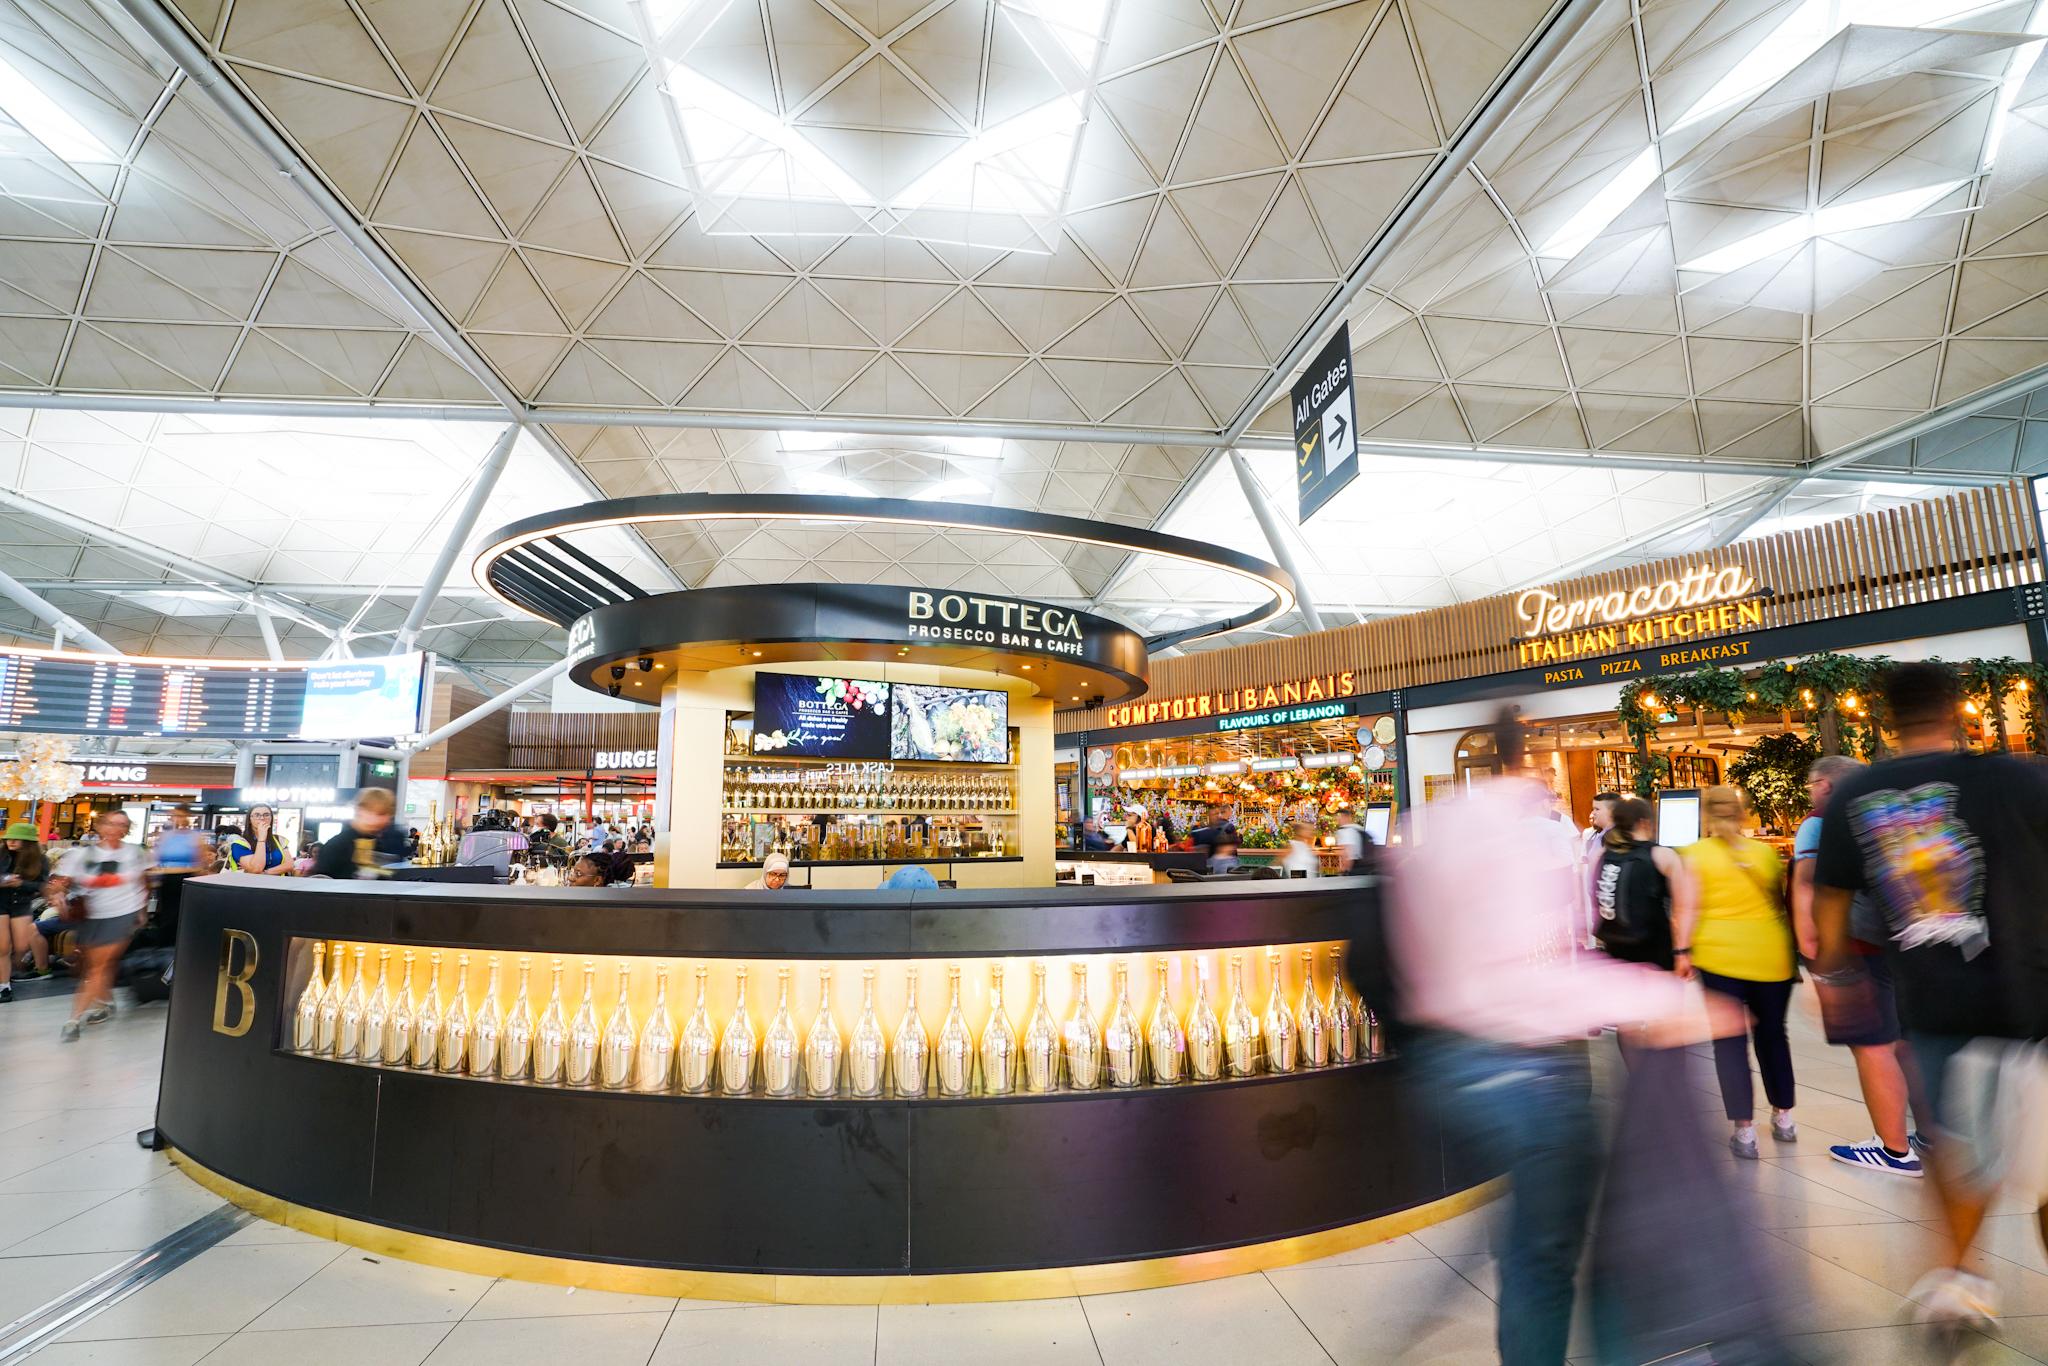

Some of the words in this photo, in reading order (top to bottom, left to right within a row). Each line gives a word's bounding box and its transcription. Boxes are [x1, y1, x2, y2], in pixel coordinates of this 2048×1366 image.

[1295, 395, 1309, 430] All
[1311, 357, 1348, 409] Gates
[909, 591, 1083, 640] BOTTEGA
[1517, 563, 1755, 637] Terracotta
[908, 624, 995, 643] PROSECCO
[1001, 633, 1030, 647] BAR
[1034, 638, 1043, 649] &
[1047, 639, 1084, 656] CAFFÈ
[1519, 625, 1618, 664] ITALIAN
[1627, 600, 1764, 645] KITCHEN
[1544, 668, 1584, 684] PASTA
[1600, 658, 1643, 676] PIZZA
[1660, 641, 1751, 667] BREAKFAST
[1107, 695, 1212, 728] COMPTOIR
[1217, 671, 1356, 713] LIBANAIS
[1219, 713, 1270, 731] FLAVOURS
[1272, 712, 1288, 724] OF
[1289, 703, 1345, 722] LEBANON
[595, 750, 658, 769] BURGE
[800, 731, 819, 742] for
[88, 765, 147, 781] KING
[211, 927, 261, 1038] B
